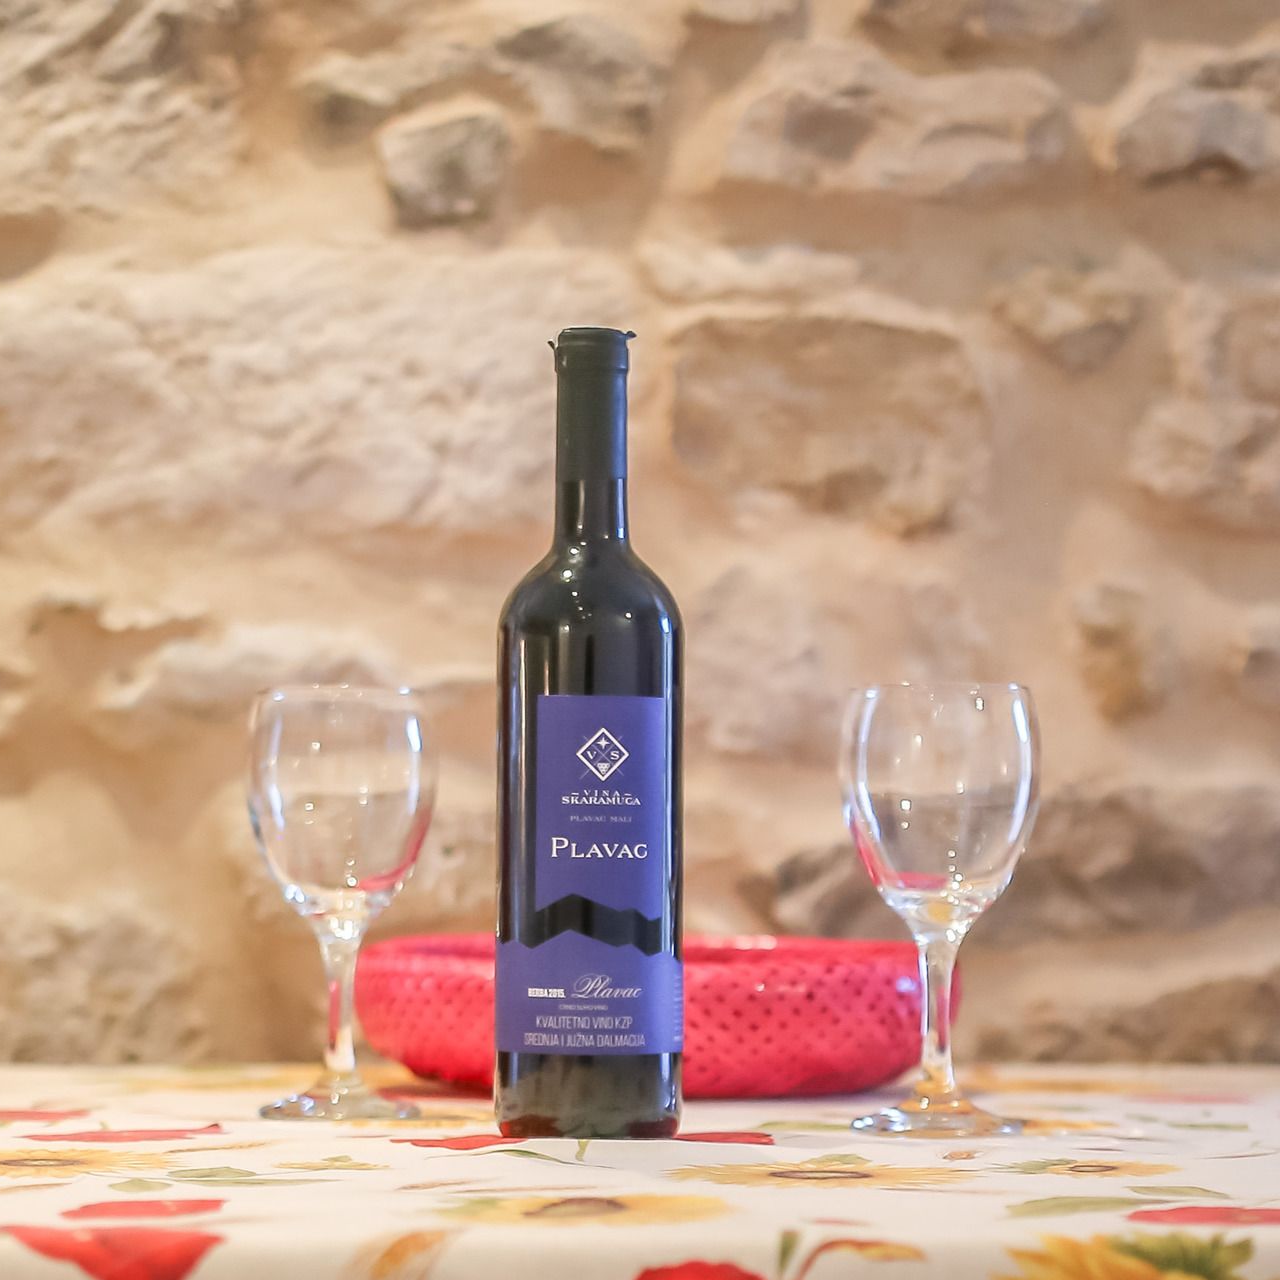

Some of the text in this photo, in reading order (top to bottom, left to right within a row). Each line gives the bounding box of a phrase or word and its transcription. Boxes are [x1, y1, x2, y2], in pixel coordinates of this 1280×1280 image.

[586, 751, 620, 760] V S
[571, 973, 643, 999] Plavac
[536, 1016, 591, 1029] KVALITETNO
[593, 1017, 614, 1029] VINO
[524, 1032, 559, 1046] SREDNJA
[566, 1033, 595, 1047] JUŽNA
[597, 1034, 646, 1047] DALMACIJA
